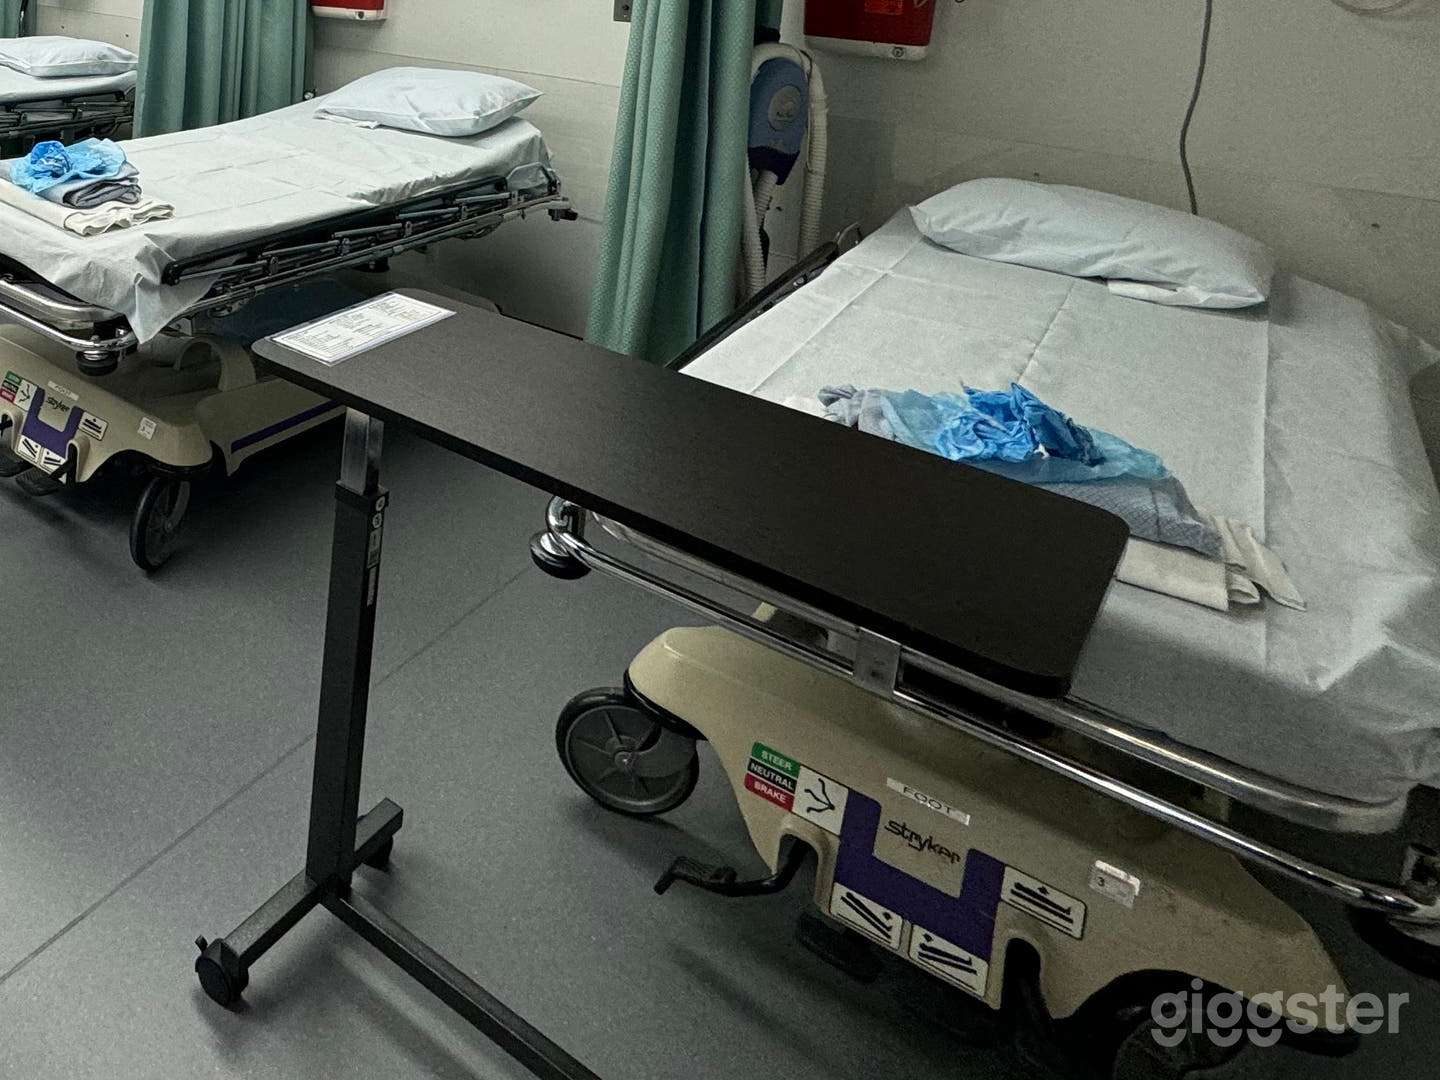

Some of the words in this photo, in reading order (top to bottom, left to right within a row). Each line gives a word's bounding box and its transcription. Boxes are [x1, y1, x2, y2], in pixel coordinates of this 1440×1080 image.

[761, 750, 793, 771] STEER
[750, 762, 795, 791] NEUTRAL
[754, 781, 787, 804] BRAKE
[903, 786, 950, 814] FOOT
[883, 820, 961, 864] stryker
